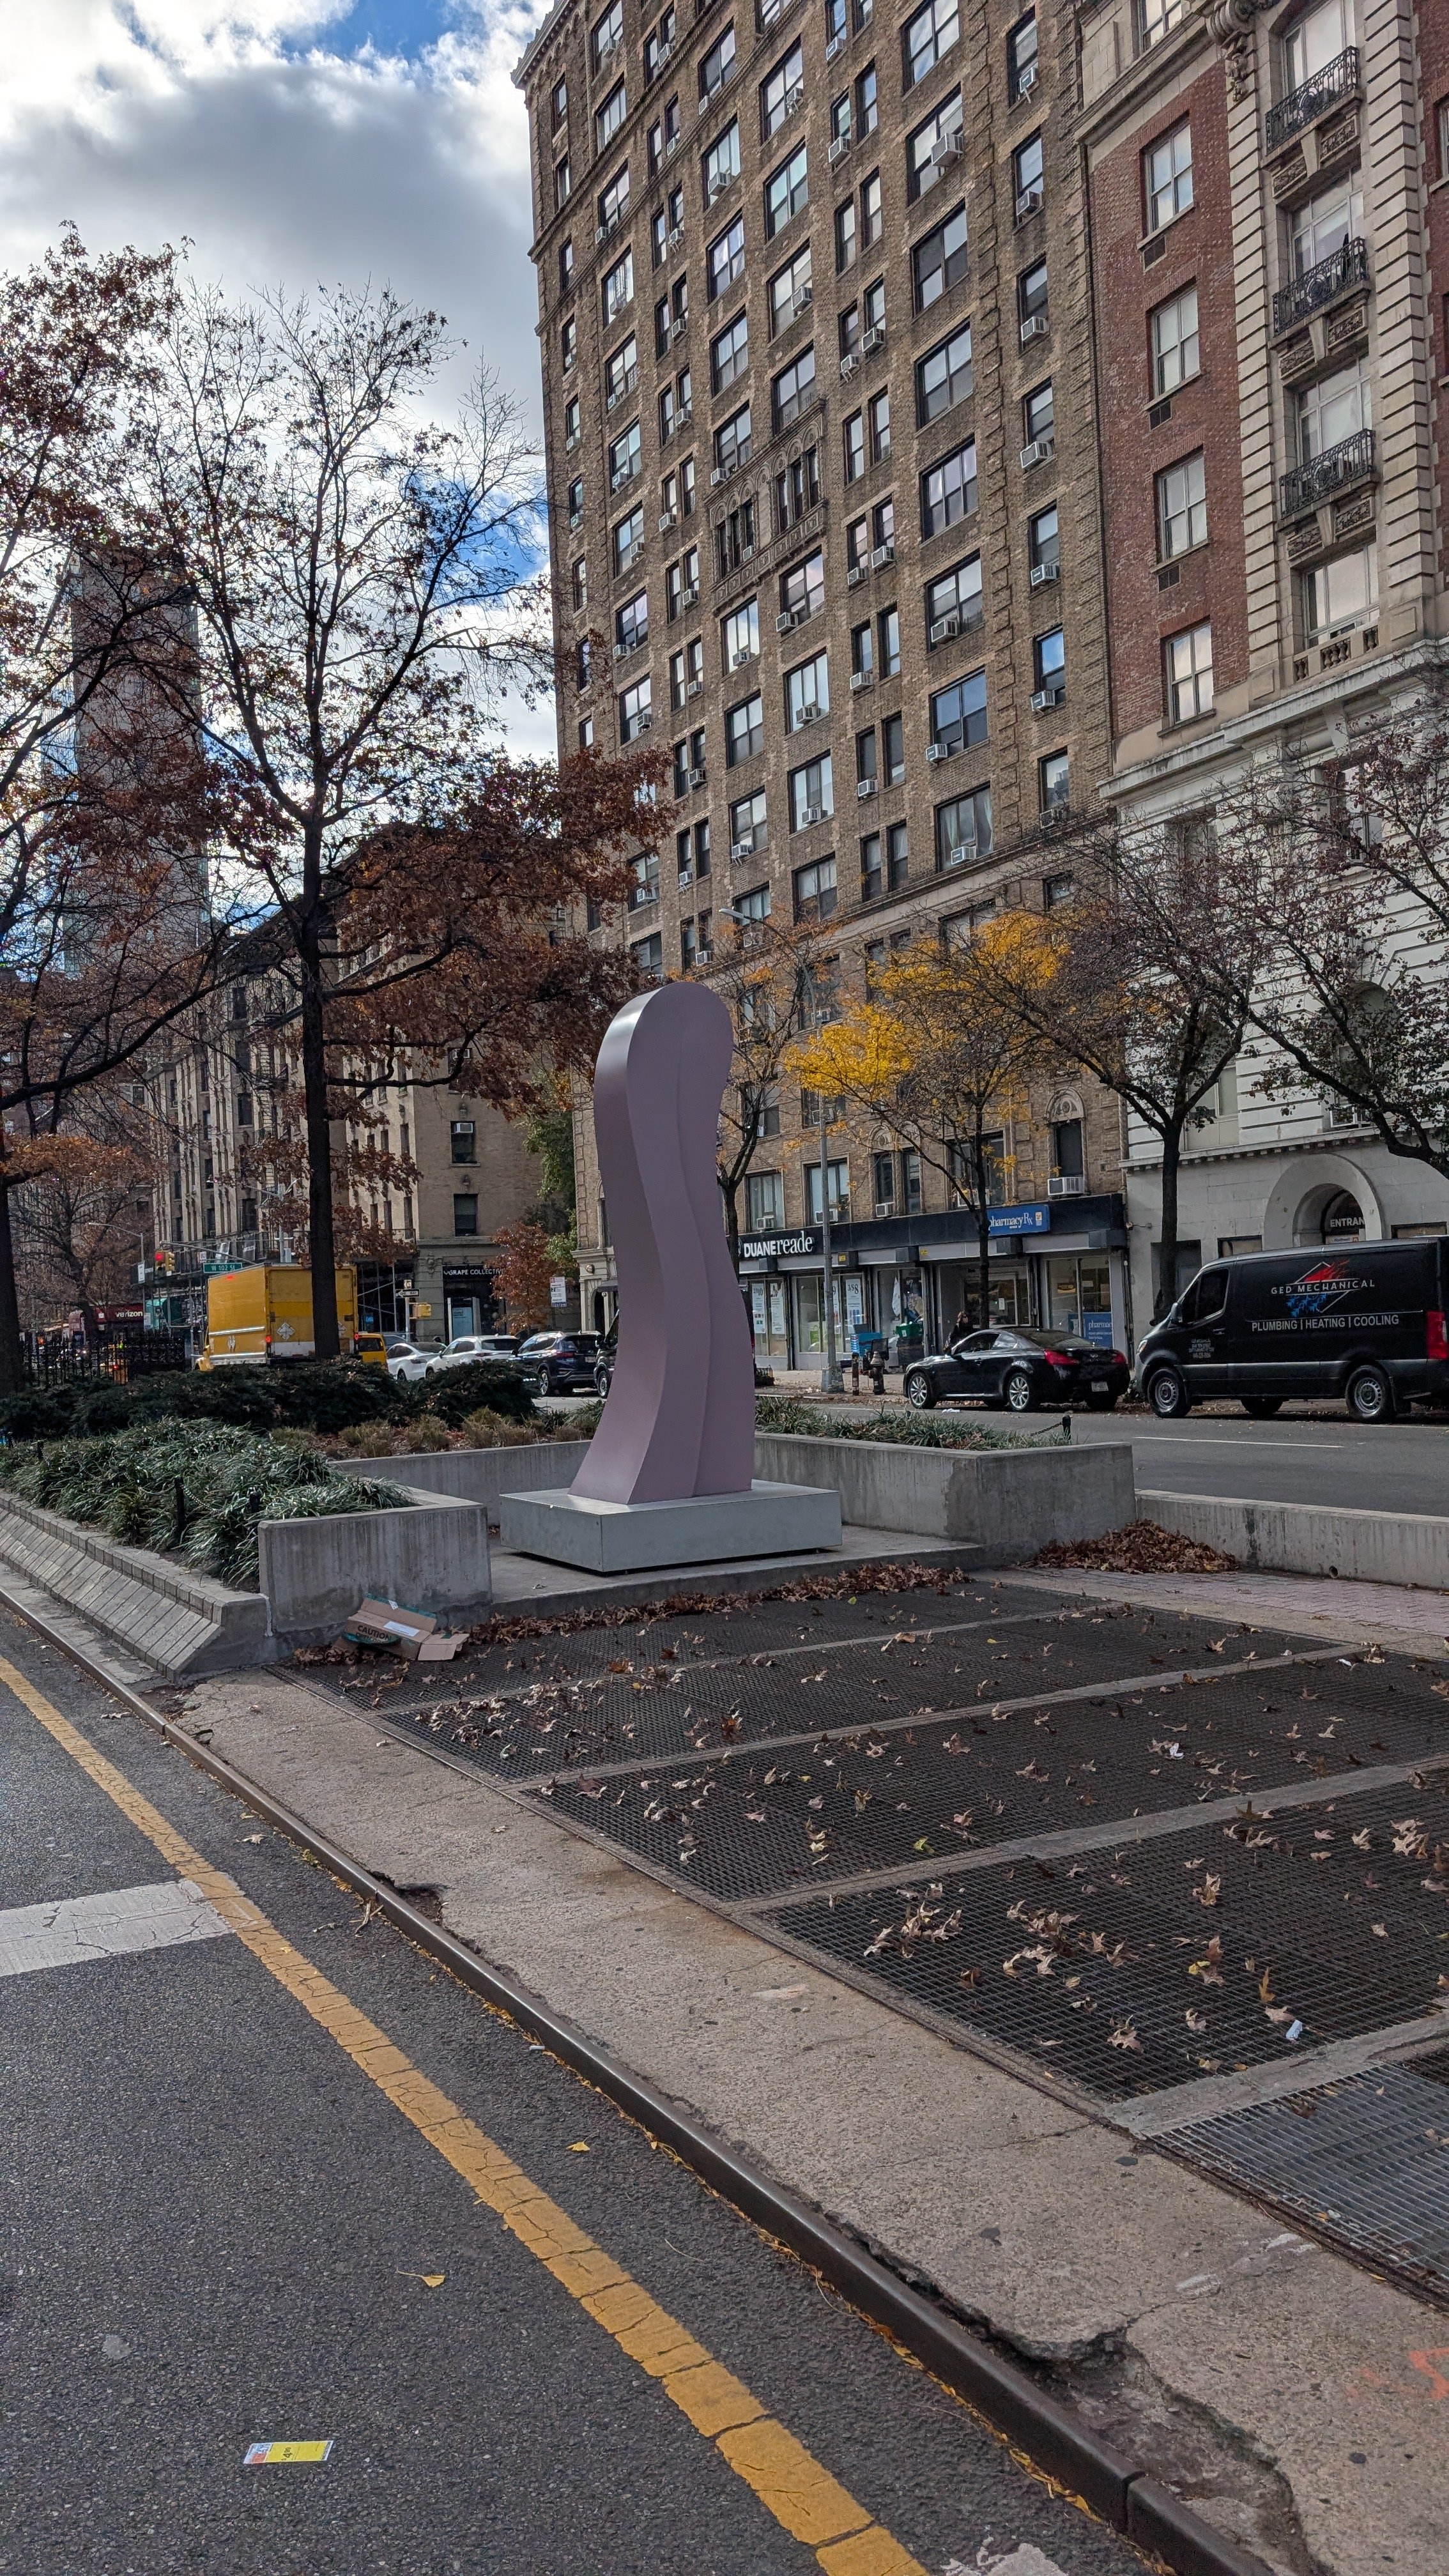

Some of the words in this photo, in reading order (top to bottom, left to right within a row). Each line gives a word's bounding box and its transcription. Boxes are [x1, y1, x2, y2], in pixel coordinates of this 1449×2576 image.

[1271, 1286, 1292, 1294] GED
[1298, 1279, 1375, 1293] MECHANICAL
[1252, 1320, 1298, 1332] PLUMBING
[1305, 1317, 1346, 1329] HEATING
[1354, 1314, 1399, 1326] COOLING
[358, 1625, 392, 1641] CAUTION
